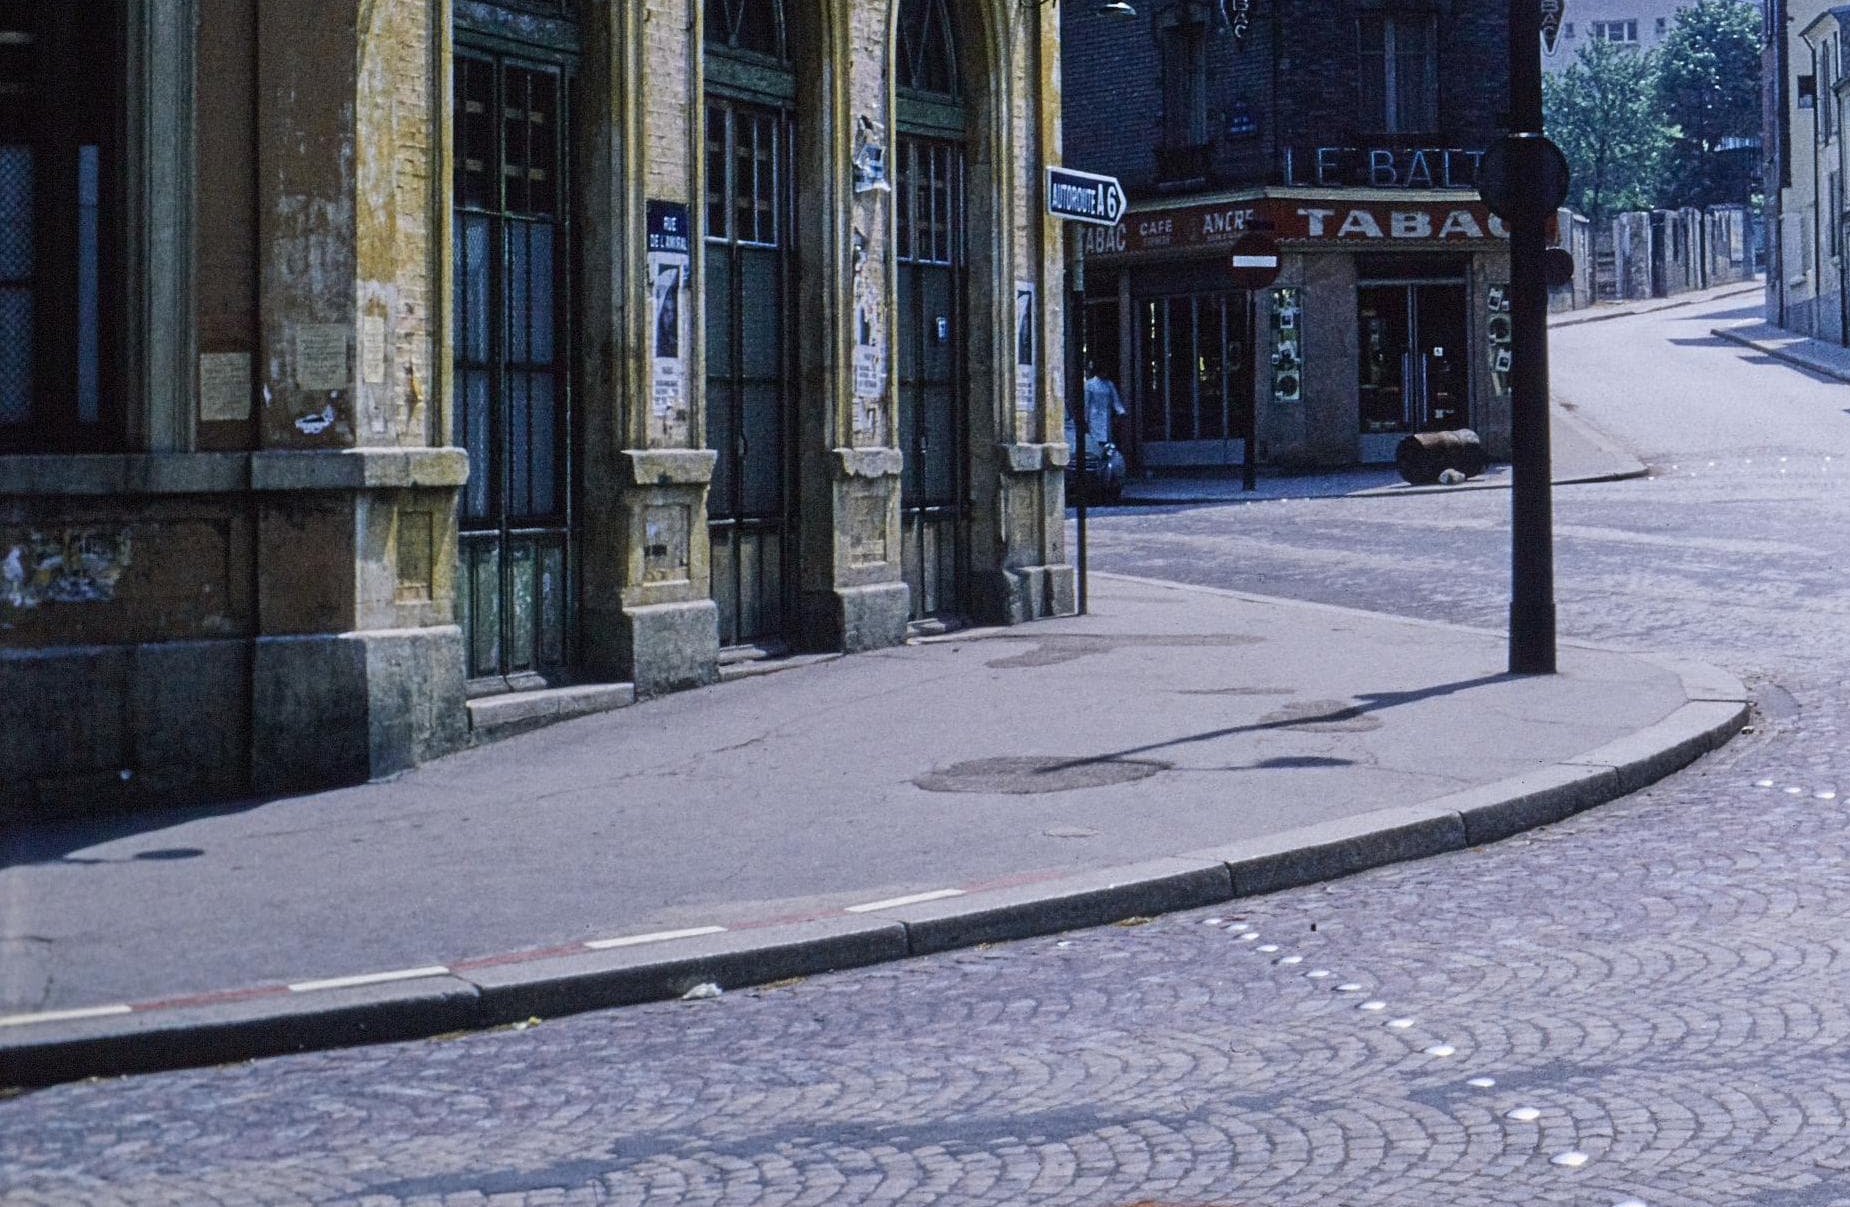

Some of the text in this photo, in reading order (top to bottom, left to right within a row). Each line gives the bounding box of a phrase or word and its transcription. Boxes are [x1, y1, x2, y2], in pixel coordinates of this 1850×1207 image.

[1286, 147, 1345, 187] LE
[1052, 182, 1096, 215] AUTOROUTE
[663, 215, 677, 232] RUE
